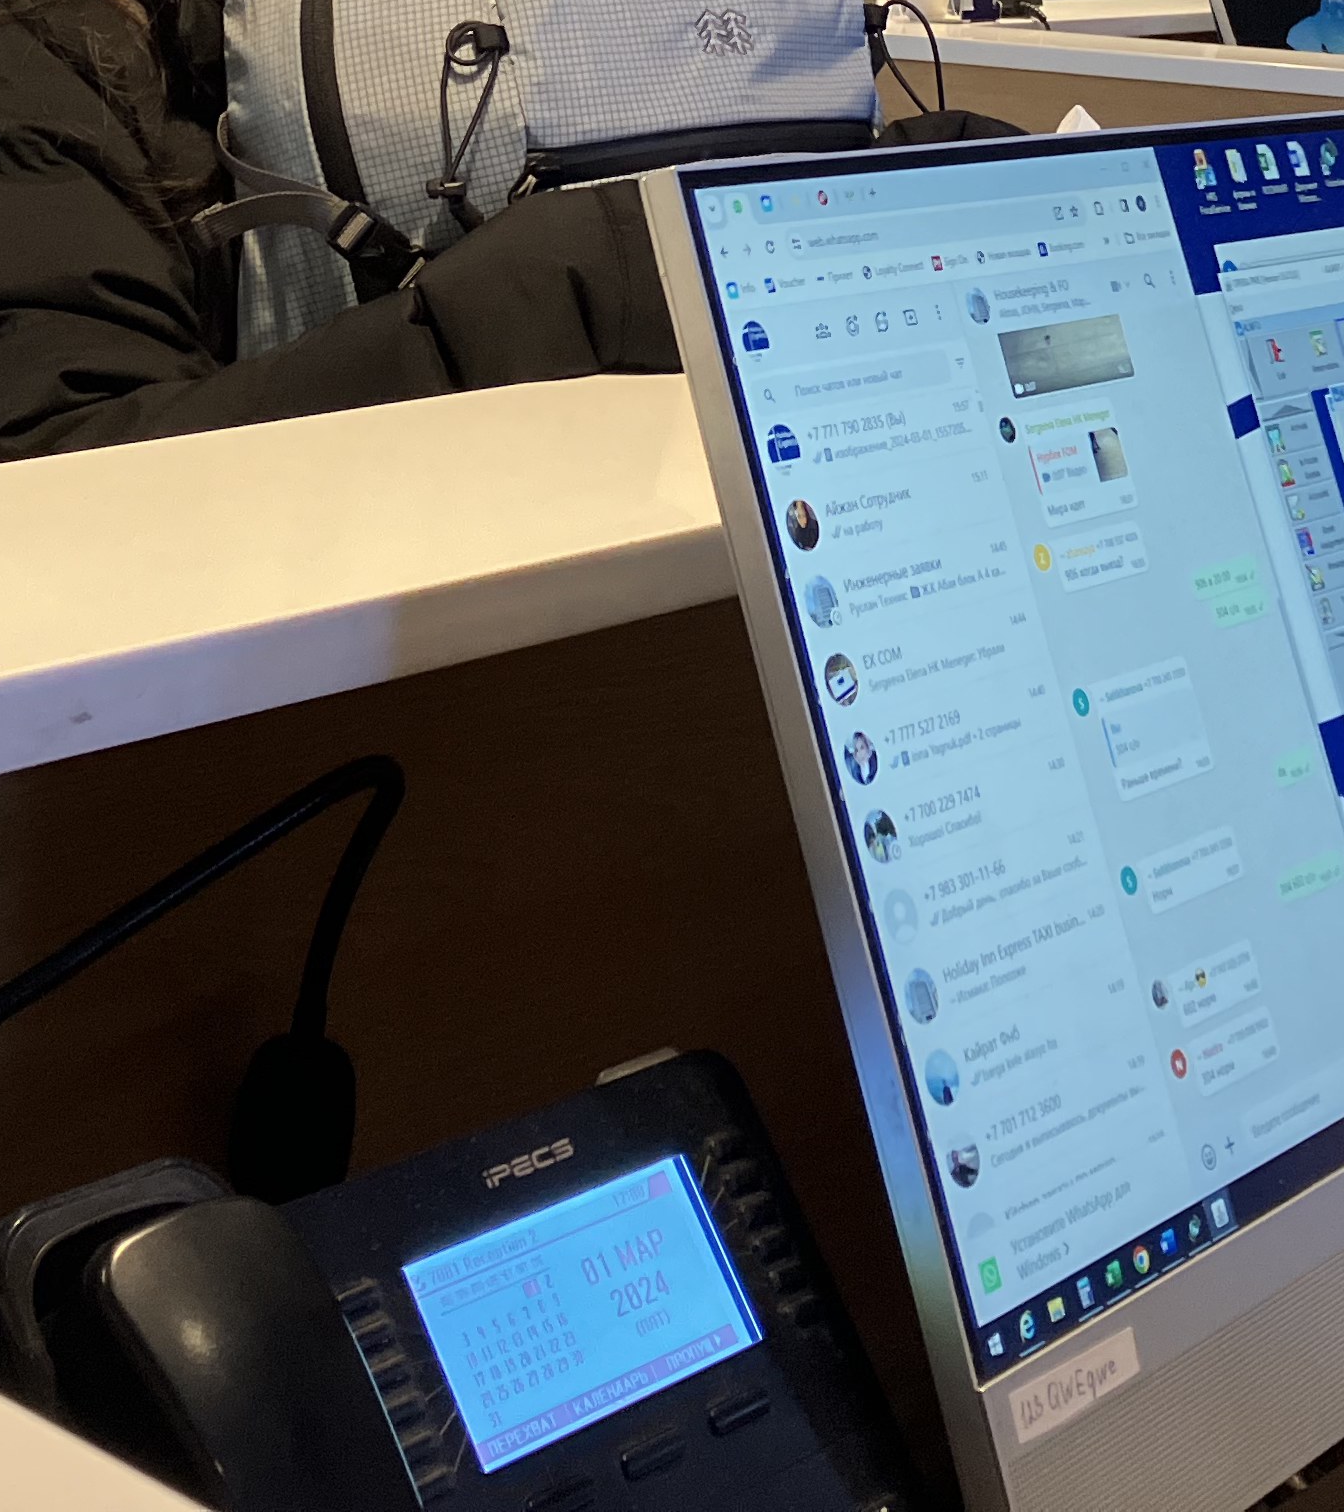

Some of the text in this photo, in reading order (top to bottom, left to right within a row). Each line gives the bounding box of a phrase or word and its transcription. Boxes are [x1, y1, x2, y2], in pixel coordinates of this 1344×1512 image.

[993, 283, 1049, 303] Housekeeping
[793, 381, 821, 397] Поиск
[861, 370, 888, 384] новый
[888, 369, 903, 380] чат
[806, 428, 821, 442] +7
[821, 424, 839, 439] 771
[861, 416, 884, 431] 2835
[824, 486, 911, 517] Айжан Сотрудник
[843, 558, 942, 595] Инженерные заявки
[1079, 564, 1099, 579] когда
[862, 646, 902, 669] EX COM
[898, 724, 916, 741] 777
[917, 718, 935, 734] 527
[936, 710, 960, 728] 2169
[918, 801, 936, 818] 700
[937, 794, 956, 811] 229
[957, 786, 980, 804] 7474
[938, 879, 957, 896] 983
[957, 860, 1005, 888] 301-11-66
[942, 956, 980, 986] Holiday
[980, 948, 997, 966] Inn
[997, 934, 1032, 962] Express
[1032, 924, 1053, 944] TAXI
[963, 1036, 998, 1065] Кайрат
[999, 1116, 1018, 1135] 701
[1019, 1106, 1037, 1126] 712
[1038, 1094, 1062, 1116] 3600
[482, 1138, 574, 1189] iPECS
[1011, 1215, 1065, 1256] Установите
[1066, 1188, 1114, 1228] WhatsApp
[461, 1234, 528, 1271] Reception
[578, 1252, 613, 1285] 01
[613, 1228, 668, 1269] МАР
[1017, 1245, 1061, 1279] Windows
[607, 1270, 672, 1317] 2024
[572, 1370, 649, 1414] КАЛЕНДАРЬ
[486, 1414, 558, 1456] ПЕРЕХВАТ
